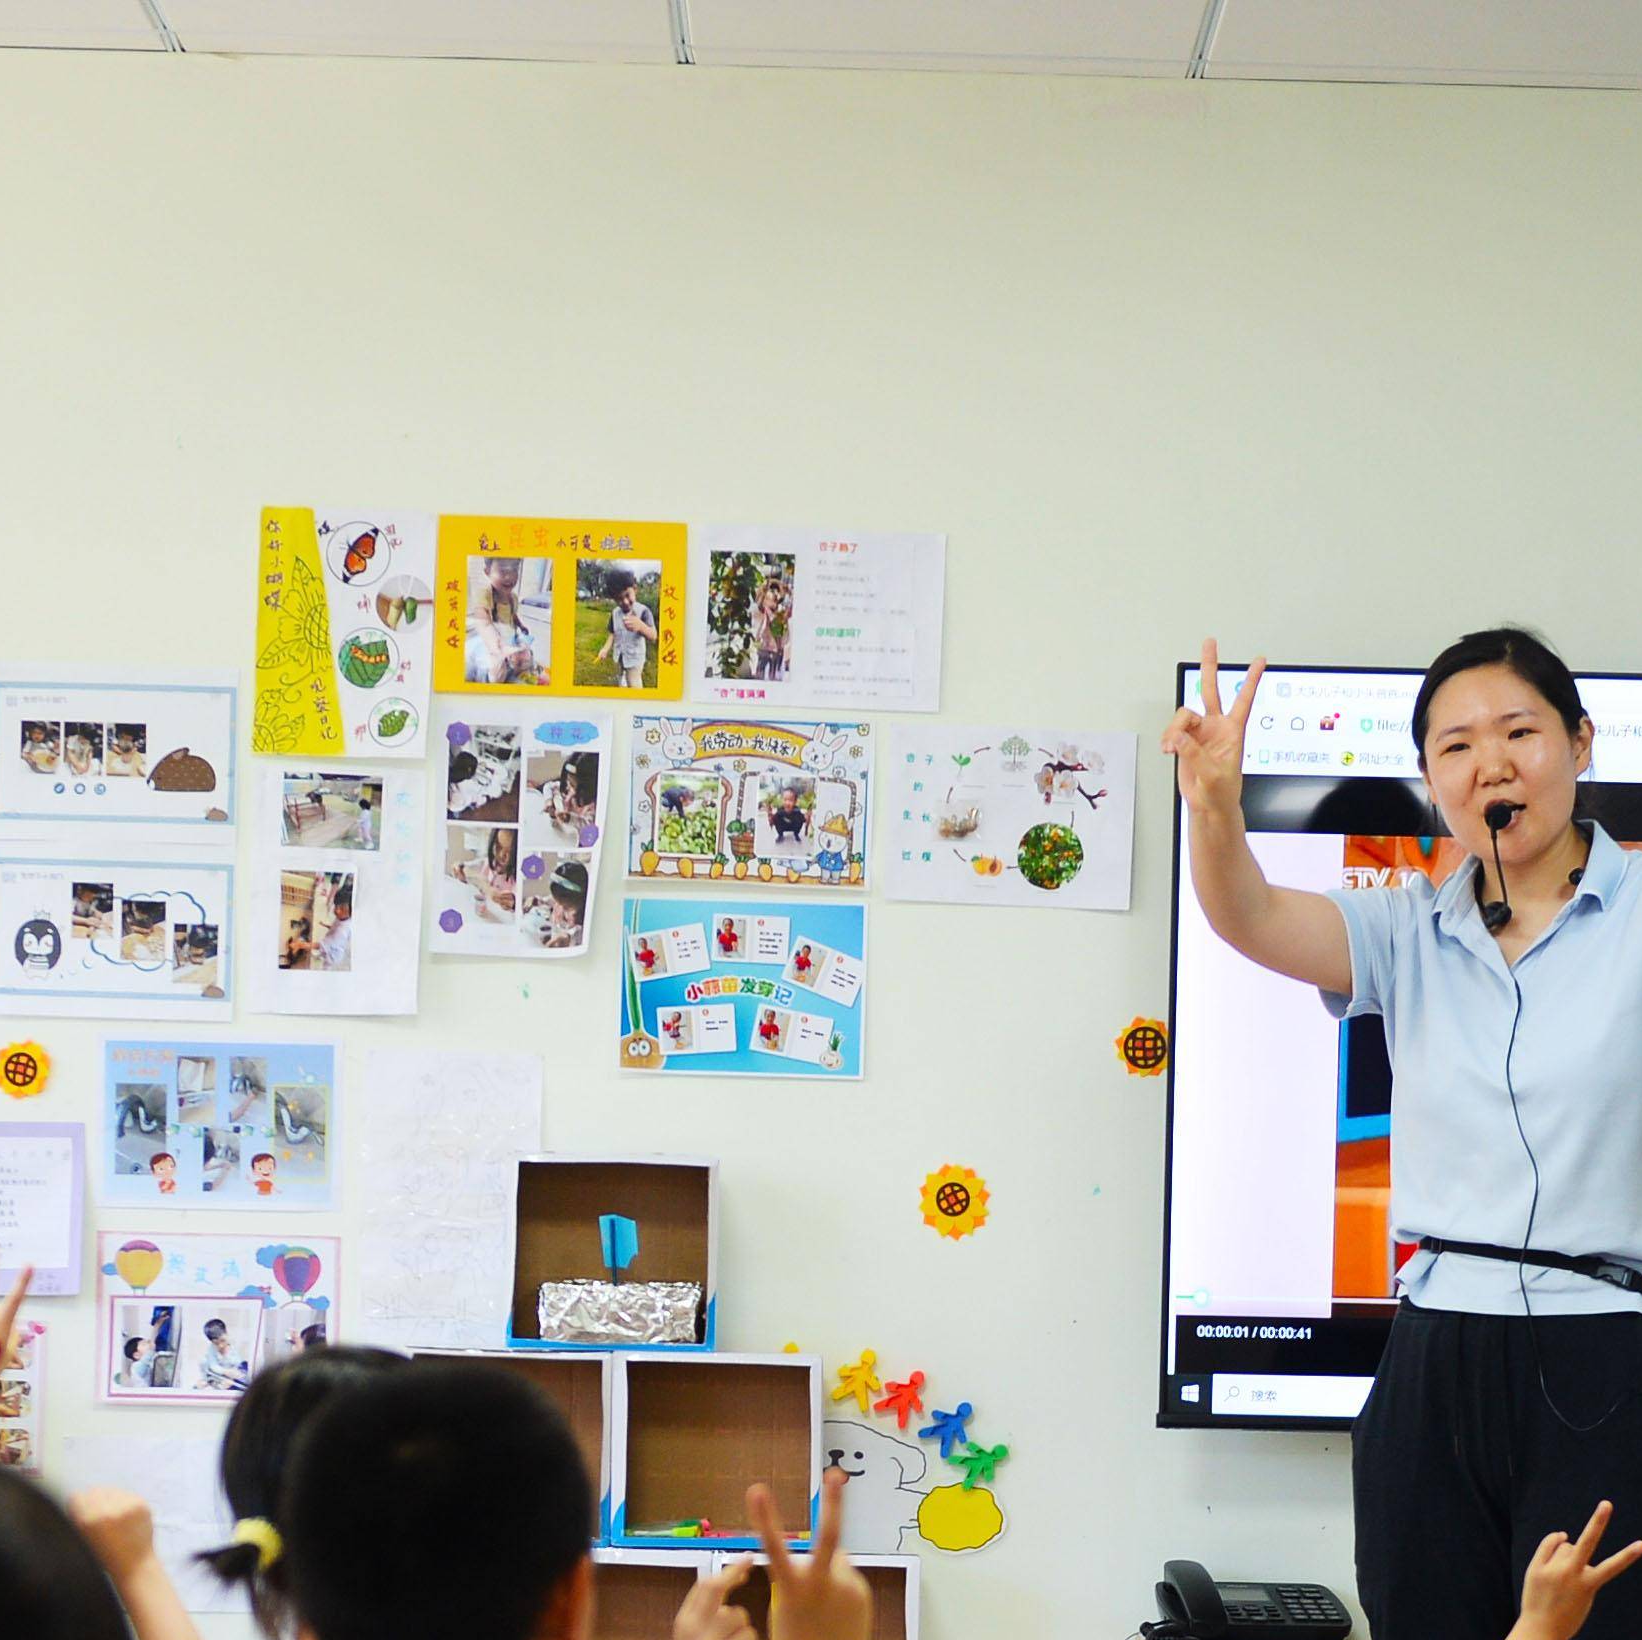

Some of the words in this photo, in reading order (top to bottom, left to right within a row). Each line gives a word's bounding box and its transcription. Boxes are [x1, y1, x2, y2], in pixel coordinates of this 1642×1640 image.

[1358, 751, 1405, 766] 网址大全
[1196, 1324, 1249, 1338] 00:00:01
[1259, 1326, 1312, 1340] 00:00:41
